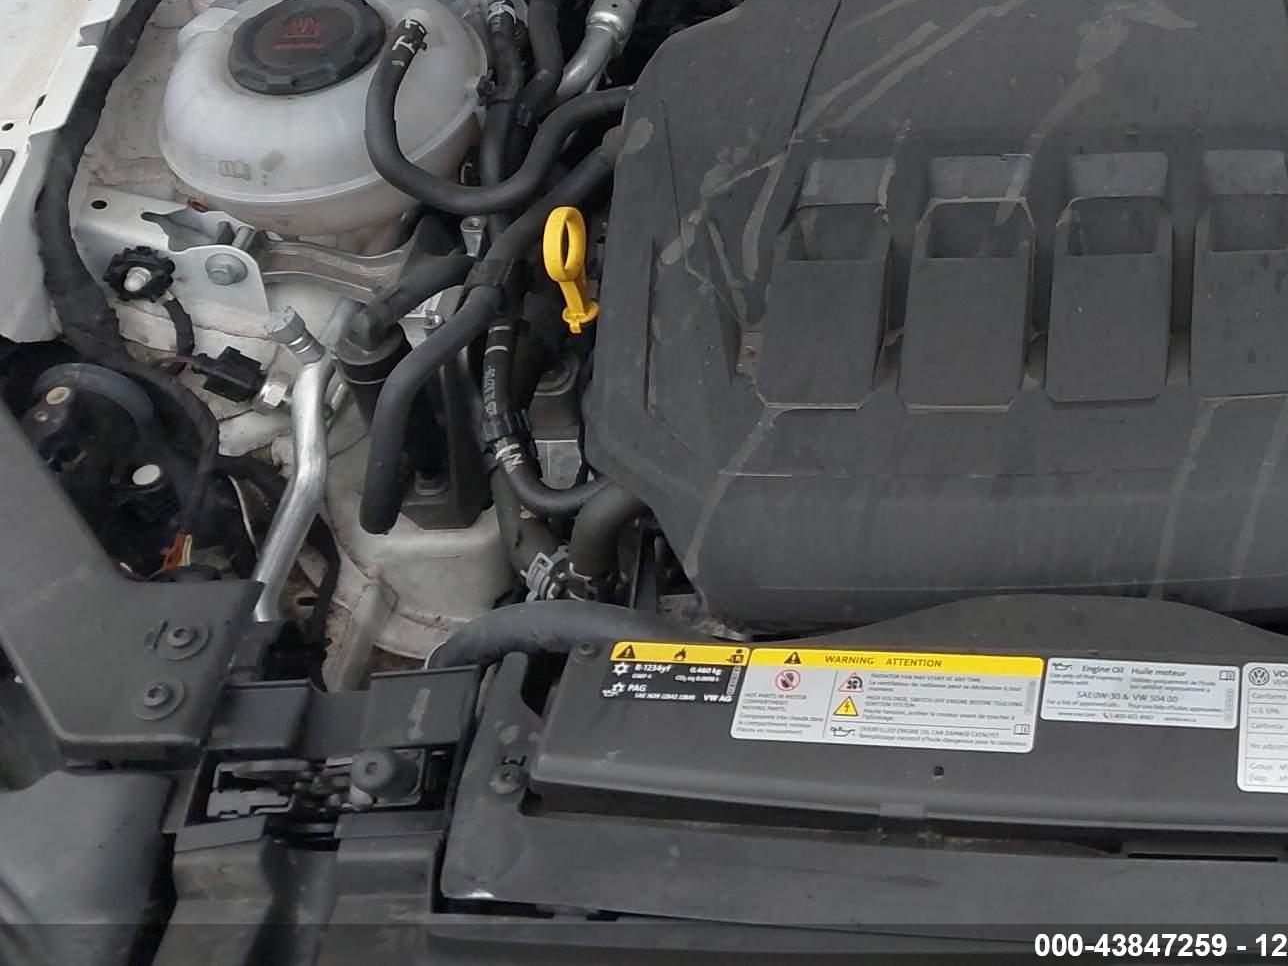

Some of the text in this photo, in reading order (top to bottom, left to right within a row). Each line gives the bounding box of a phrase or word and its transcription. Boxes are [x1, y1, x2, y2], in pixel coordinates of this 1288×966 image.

[824, 654, 942, 668] WARNING ATTENTION
[634, 663, 671, 673] R-1234yf
[712, 667, 722, 675] kg
[1082, 665, 1123, 674] Engine Oil
[703, 694, 716, 702] VW
